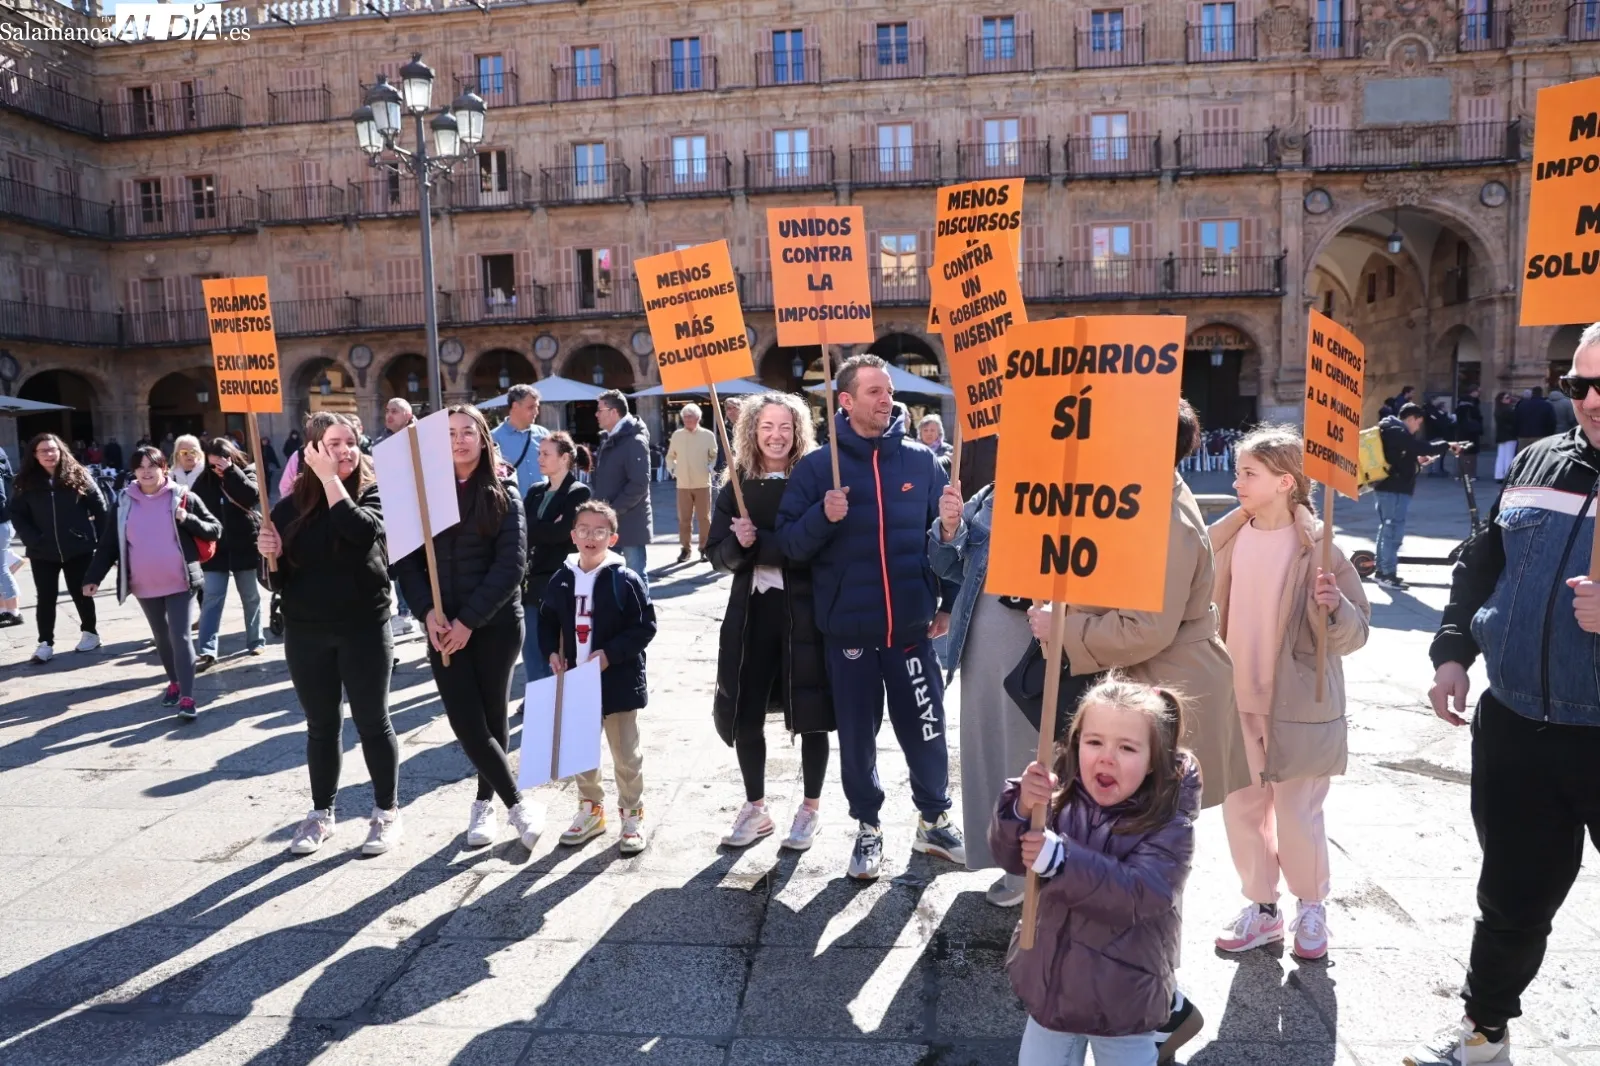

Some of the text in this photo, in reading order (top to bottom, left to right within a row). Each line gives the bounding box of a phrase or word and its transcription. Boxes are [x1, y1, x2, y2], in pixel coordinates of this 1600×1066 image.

[947, 184, 1010, 212] MENOS
[778, 217, 852, 238] UNIDOS
[937, 210, 1021, 238] DISCURSOS
[782, 245, 853, 264] CONTRA
[943, 243, 994, 281] CONTRA
[656, 263, 711, 289] MENOS
[807, 273, 834, 291] LA
[961, 274, 982, 299] UN
[209, 293, 267, 314] PAGAMOS
[646, 281, 735, 312] IMPOSICIONES
[949, 289, 1007, 326] GOBIERNO
[210, 315, 272, 334] IMPUESTOS
[778, 301, 871, 323] IMPOSICIÓN
[675, 314, 715, 340] MÁS
[953, 311, 1013, 353] AUSENTE
[216, 353, 275, 371] EXIGIMOS
[658, 334, 747, 367] SOLUCIONES
[1005, 342, 1179, 379] SOLIDARIOS
[1311, 354, 1323, 374] NI
[1312, 329, 1361, 372] NI CENTROS
[977, 353, 998, 377] UN
[220, 379, 279, 395] SERVICIOS
[1051, 385, 1092, 440] SÍ
[1307, 385, 1360, 428] A LA MONCLOA
[1327, 420, 1344, 443] LOS
[1306, 439, 1357, 477] EXPERIMENTOS
[1014, 482, 1142, 520] TONTOS
[1040, 534, 1098, 578] NO
[906, 657, 942, 741] PARIS
